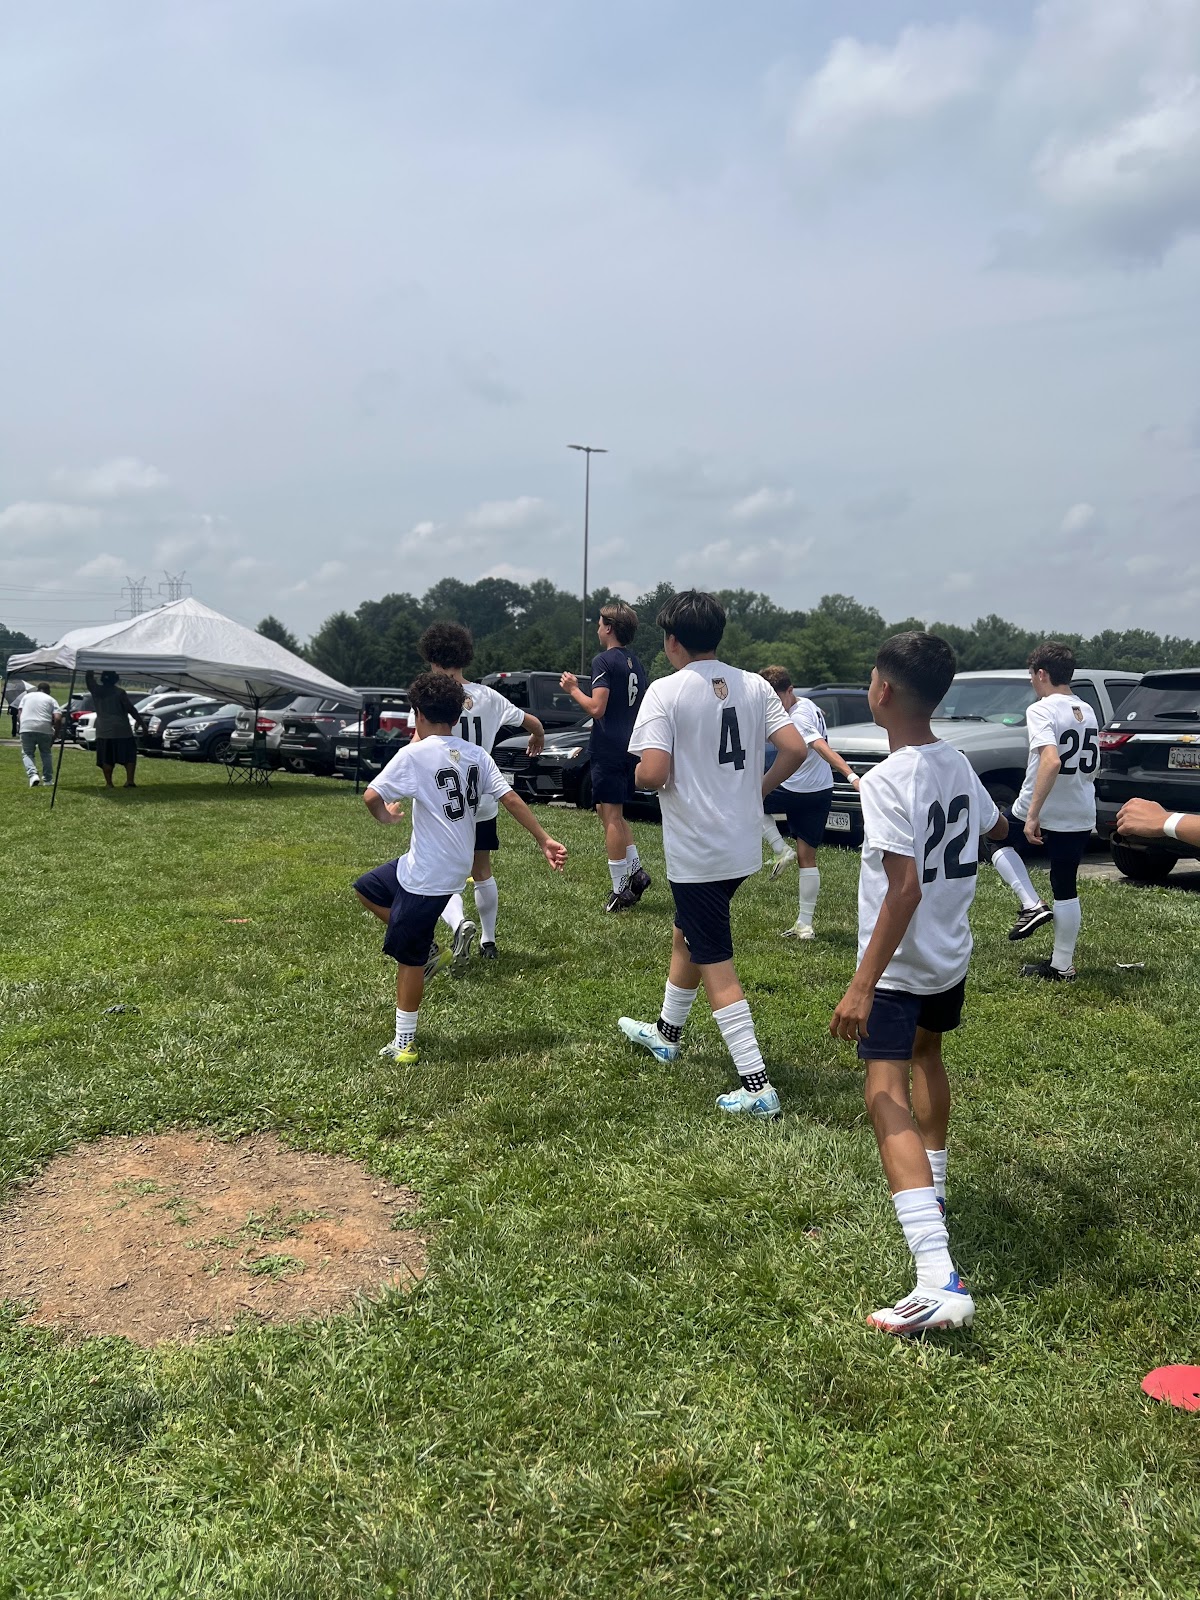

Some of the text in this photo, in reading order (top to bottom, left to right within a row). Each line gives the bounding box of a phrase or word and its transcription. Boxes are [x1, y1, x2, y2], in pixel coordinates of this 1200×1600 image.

[628, 672, 639, 707] 6
[459, 716, 483, 747] 11
[718, 706, 746, 771] 4
[1058, 727, 1098, 774] 25
[434, 764, 480, 822] 34
[922, 794, 978, 884] 22
